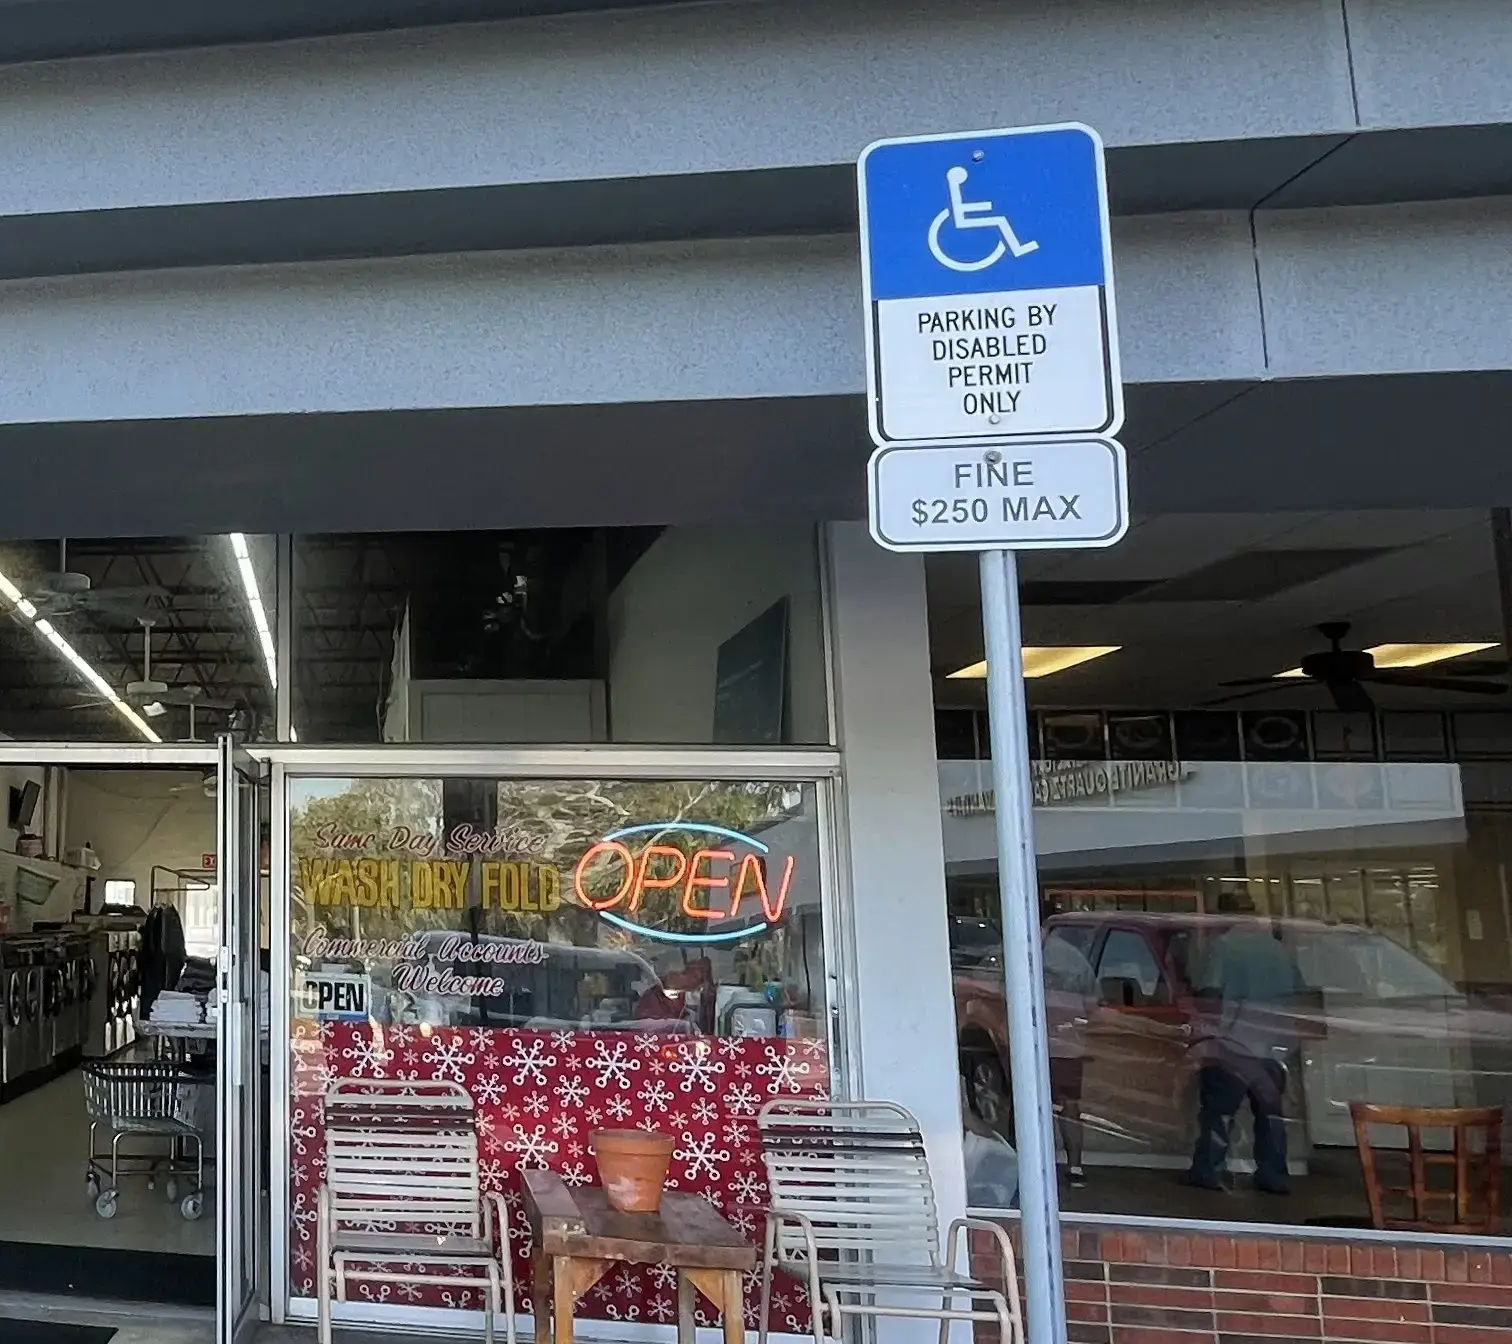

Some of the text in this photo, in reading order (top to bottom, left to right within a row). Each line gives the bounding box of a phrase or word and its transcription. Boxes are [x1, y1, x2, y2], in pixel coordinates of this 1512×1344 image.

[918, 304, 1057, 334] PARKING BY
[933, 333, 1046, 361] DISABLED
[948, 362, 1033, 388] PERMIT
[963, 391, 1022, 415] ONLY
[955, 461, 1034, 489] FINE
[912, 494, 1082, 526] $250 MAX
[314, 821, 548, 856] Same Day Service
[299, 857, 561, 911] WASH DRY FOLD
[575, 841, 794, 923] OPEN
[302, 925, 549, 965] Commercial Accounts
[393, 962, 505, 996] Welcome
[303, 981, 364, 1011] OPEN
